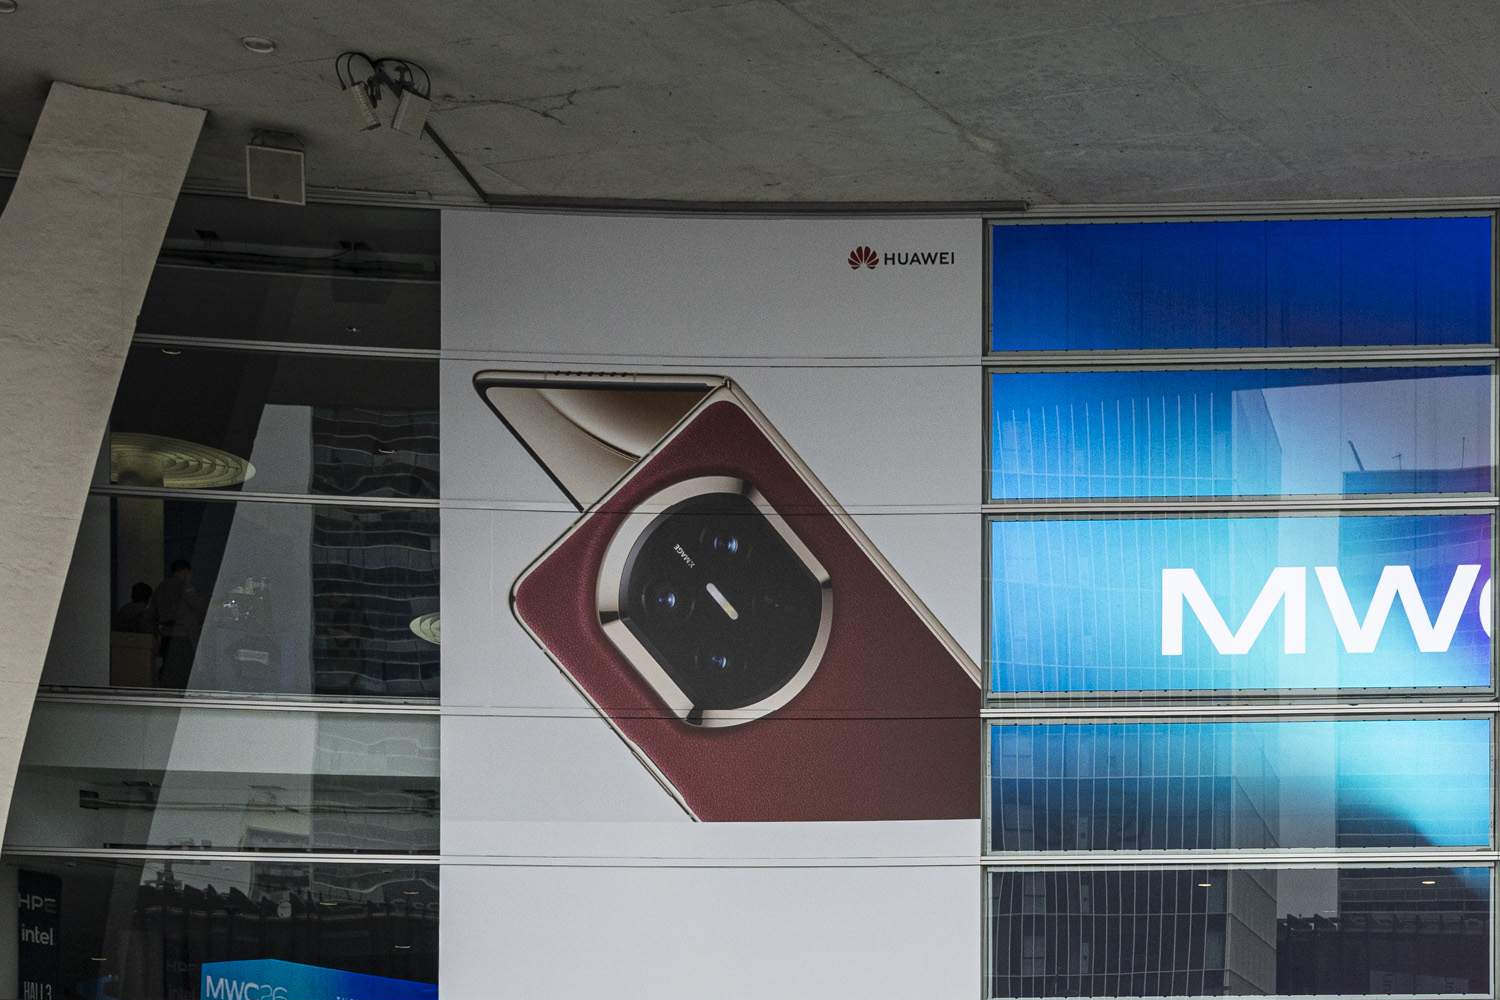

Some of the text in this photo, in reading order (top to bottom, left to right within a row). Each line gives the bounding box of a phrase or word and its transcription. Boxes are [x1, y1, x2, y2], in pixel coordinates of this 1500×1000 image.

[883, 251, 955, 266] HUAWEI
[673, 543, 696, 568] XMAGE
[21, 923, 54, 946] intel
